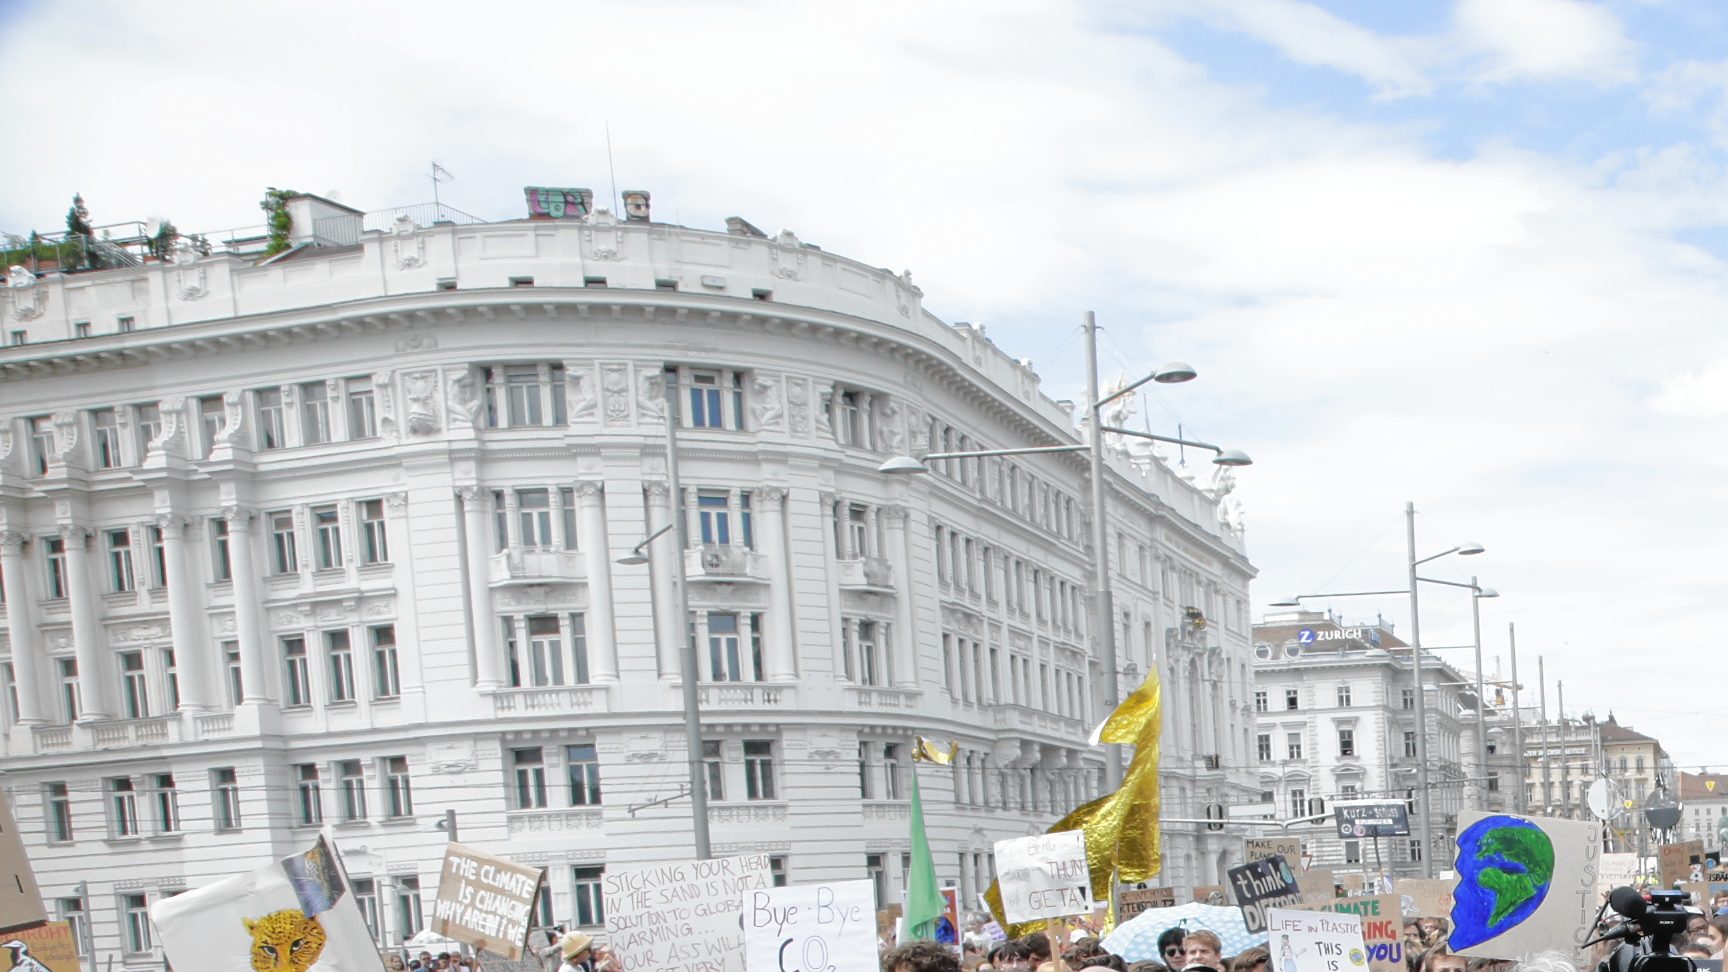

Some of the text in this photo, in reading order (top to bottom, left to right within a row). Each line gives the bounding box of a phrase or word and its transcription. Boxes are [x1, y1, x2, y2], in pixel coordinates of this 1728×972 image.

[1317, 628, 1361, 641] ZURICH
[1247, 840, 1296, 854] MAKE OUR
[449, 856, 535, 898] THE CLIMATE
[605, 855, 769, 895] STICKING YOUR HEAD
[1237, 861, 1286, 898] think
[458, 879, 531, 926] IS CHANGING
[606, 873, 767, 914] IN THE SAND IS NOT A
[436, 899, 465, 924] WHY
[507, 923, 526, 947] WE
[608, 899, 743, 935] SOLUTION TO GLOBA
[754, 887, 861, 937] Bye Bye
[1270, 913, 1302, 931] LIFE
[1320, 919, 1360, 934] PLASTIC
[668, 943, 702, 964] ASS
[1315, 941, 1343, 957] THIS
[1327, 960, 1339, 972] IS
[1364, 942, 1402, 963] YOU
